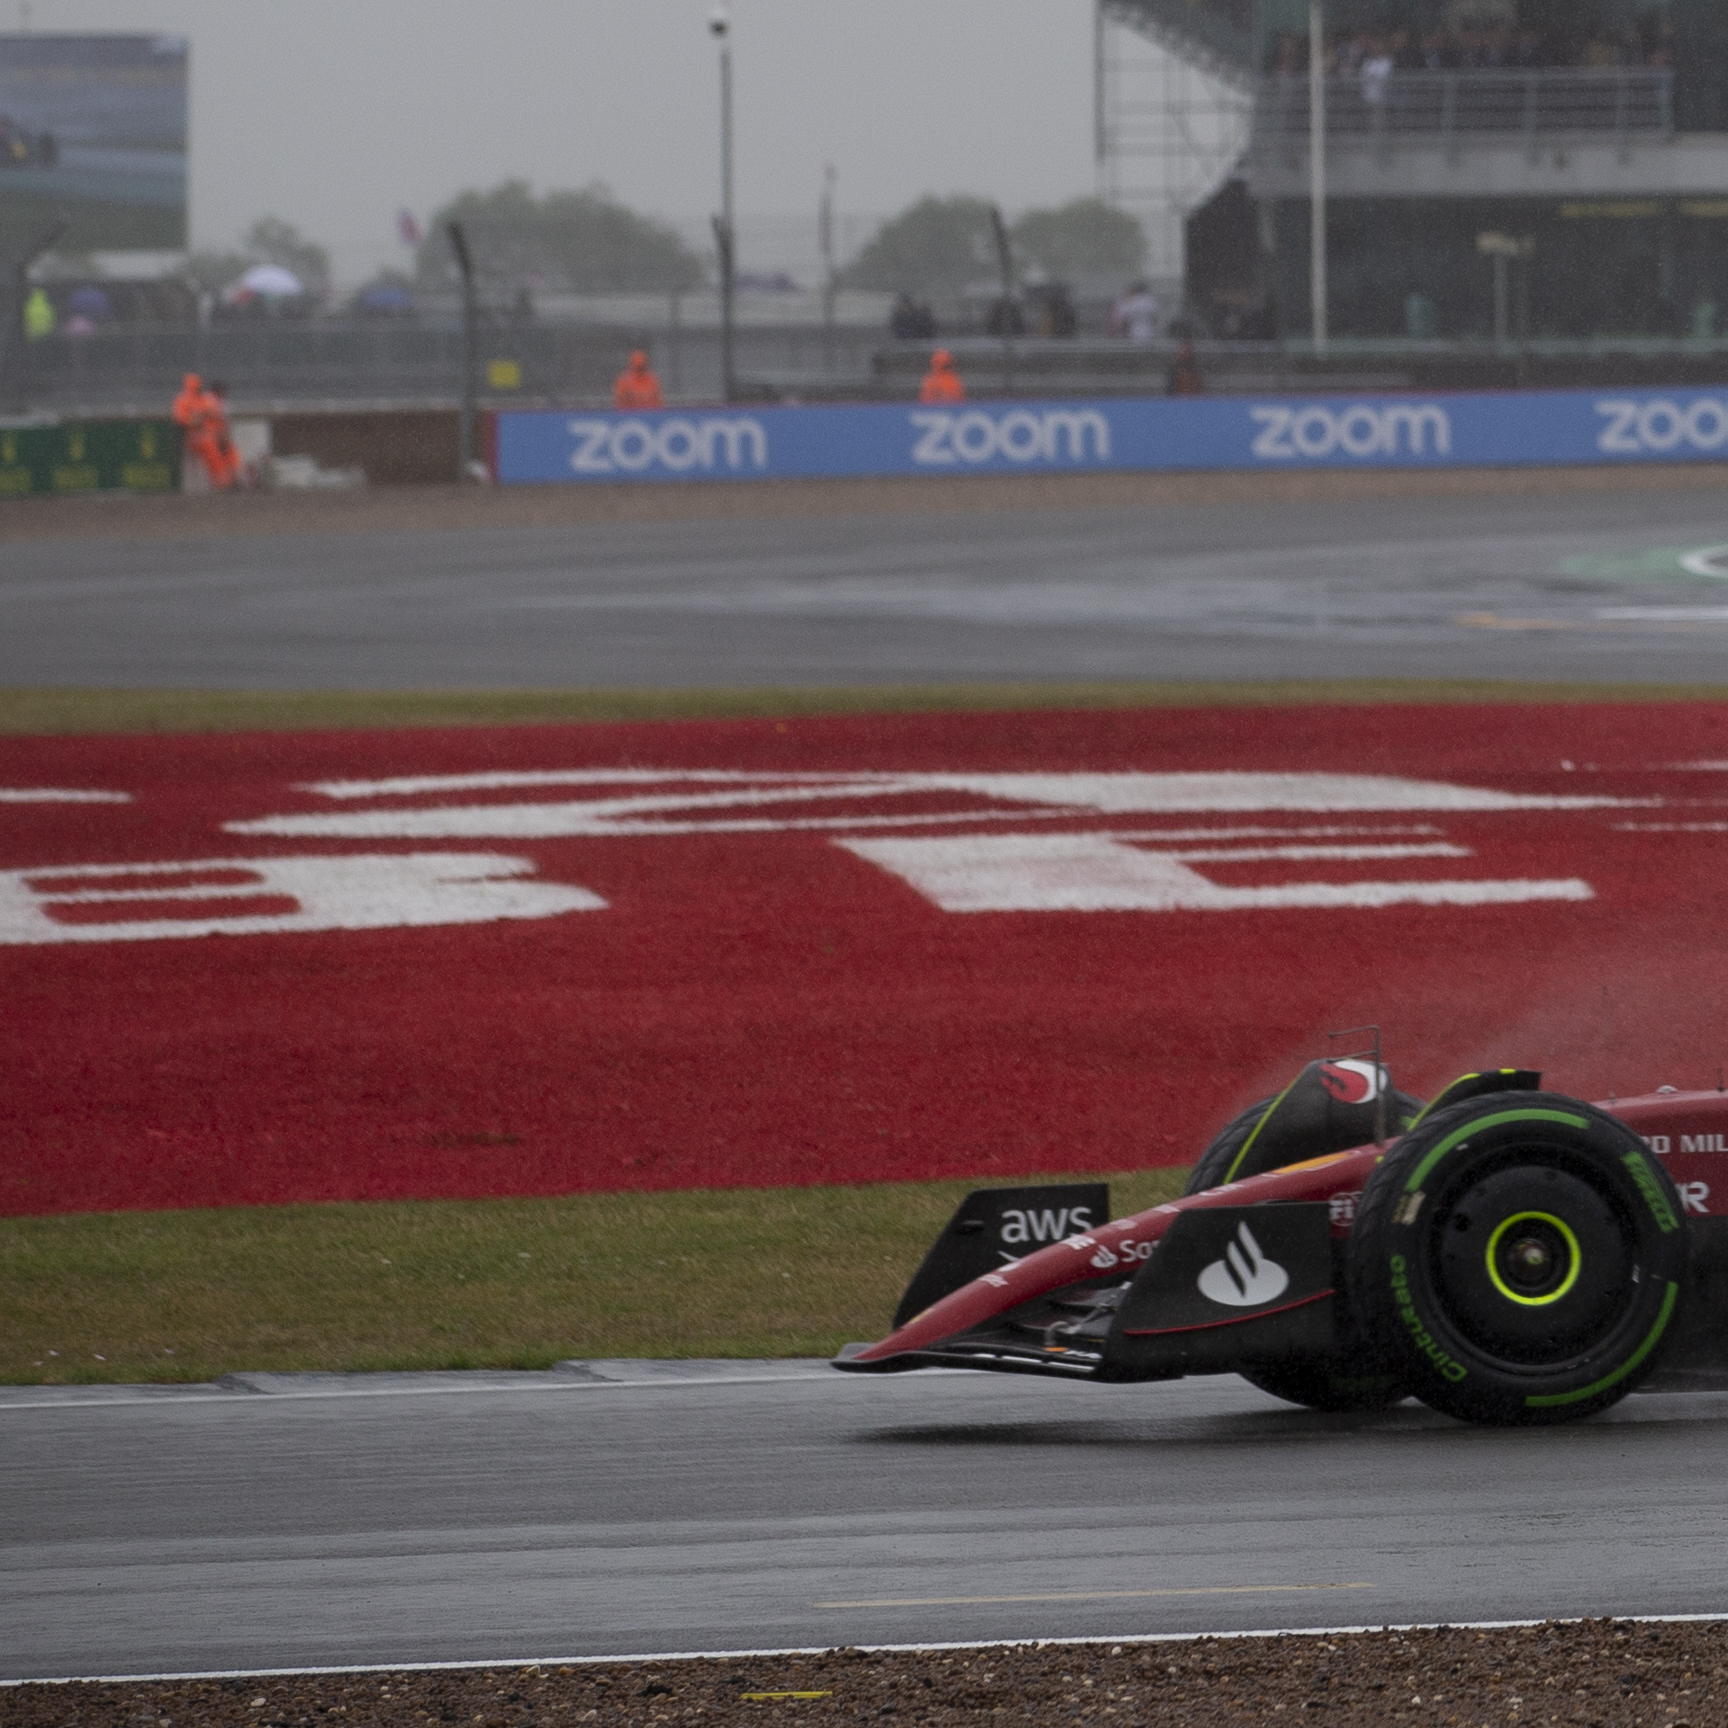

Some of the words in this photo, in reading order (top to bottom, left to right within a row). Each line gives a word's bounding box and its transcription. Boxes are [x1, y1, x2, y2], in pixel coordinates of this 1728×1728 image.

[570, 419, 765, 471] zoom
[912, 411, 1108, 462] zoom
[1252, 405, 1449, 457] zoom
[1000, 1206, 1093, 1244] aws
